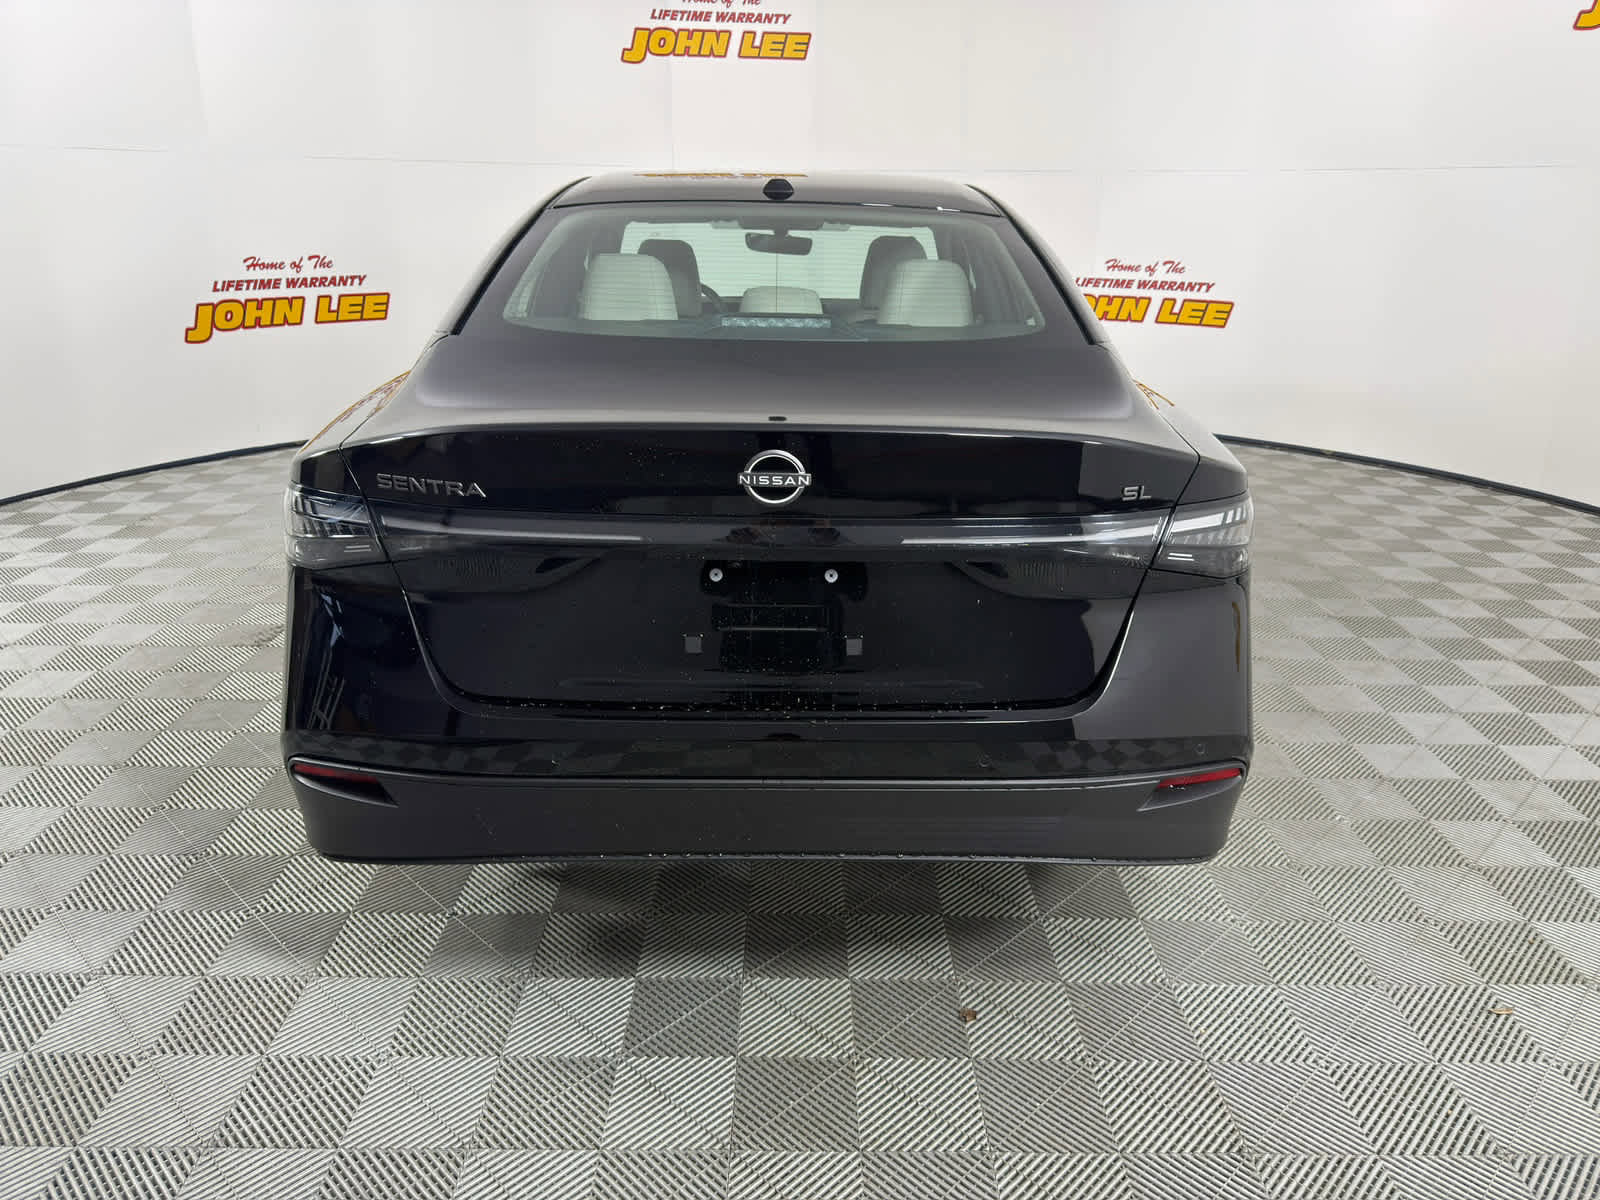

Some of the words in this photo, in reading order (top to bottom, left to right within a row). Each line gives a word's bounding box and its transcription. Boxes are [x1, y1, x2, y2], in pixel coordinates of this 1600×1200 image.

[650, 8, 713, 23] LIFETIME
[715, 11, 792, 25] WARRANTY
[620, 26, 732, 64] JOHN
[738, 30, 812, 61] LEE
[243, 255, 286, 272] Home
[289, 256, 304, 274] of
[307, 253, 334, 270] The
[1104, 258, 1142, 273] Home
[1144, 261, 1160, 277] of
[1162, 260, 1186, 274] The
[212, 277, 282, 293] LIFETIME
[285, 274, 367, 290] WARRANTY
[1136, 279, 1216, 293] WARRANTY
[184, 296, 305, 344] JOHN
[314, 292, 390, 324] LEE
[1154, 297, 1235, 329] LEE
[376, 472, 487, 498] SENTRA
[739, 475, 810, 486] NISSAN
[1121, 485, 1152, 501] SL
